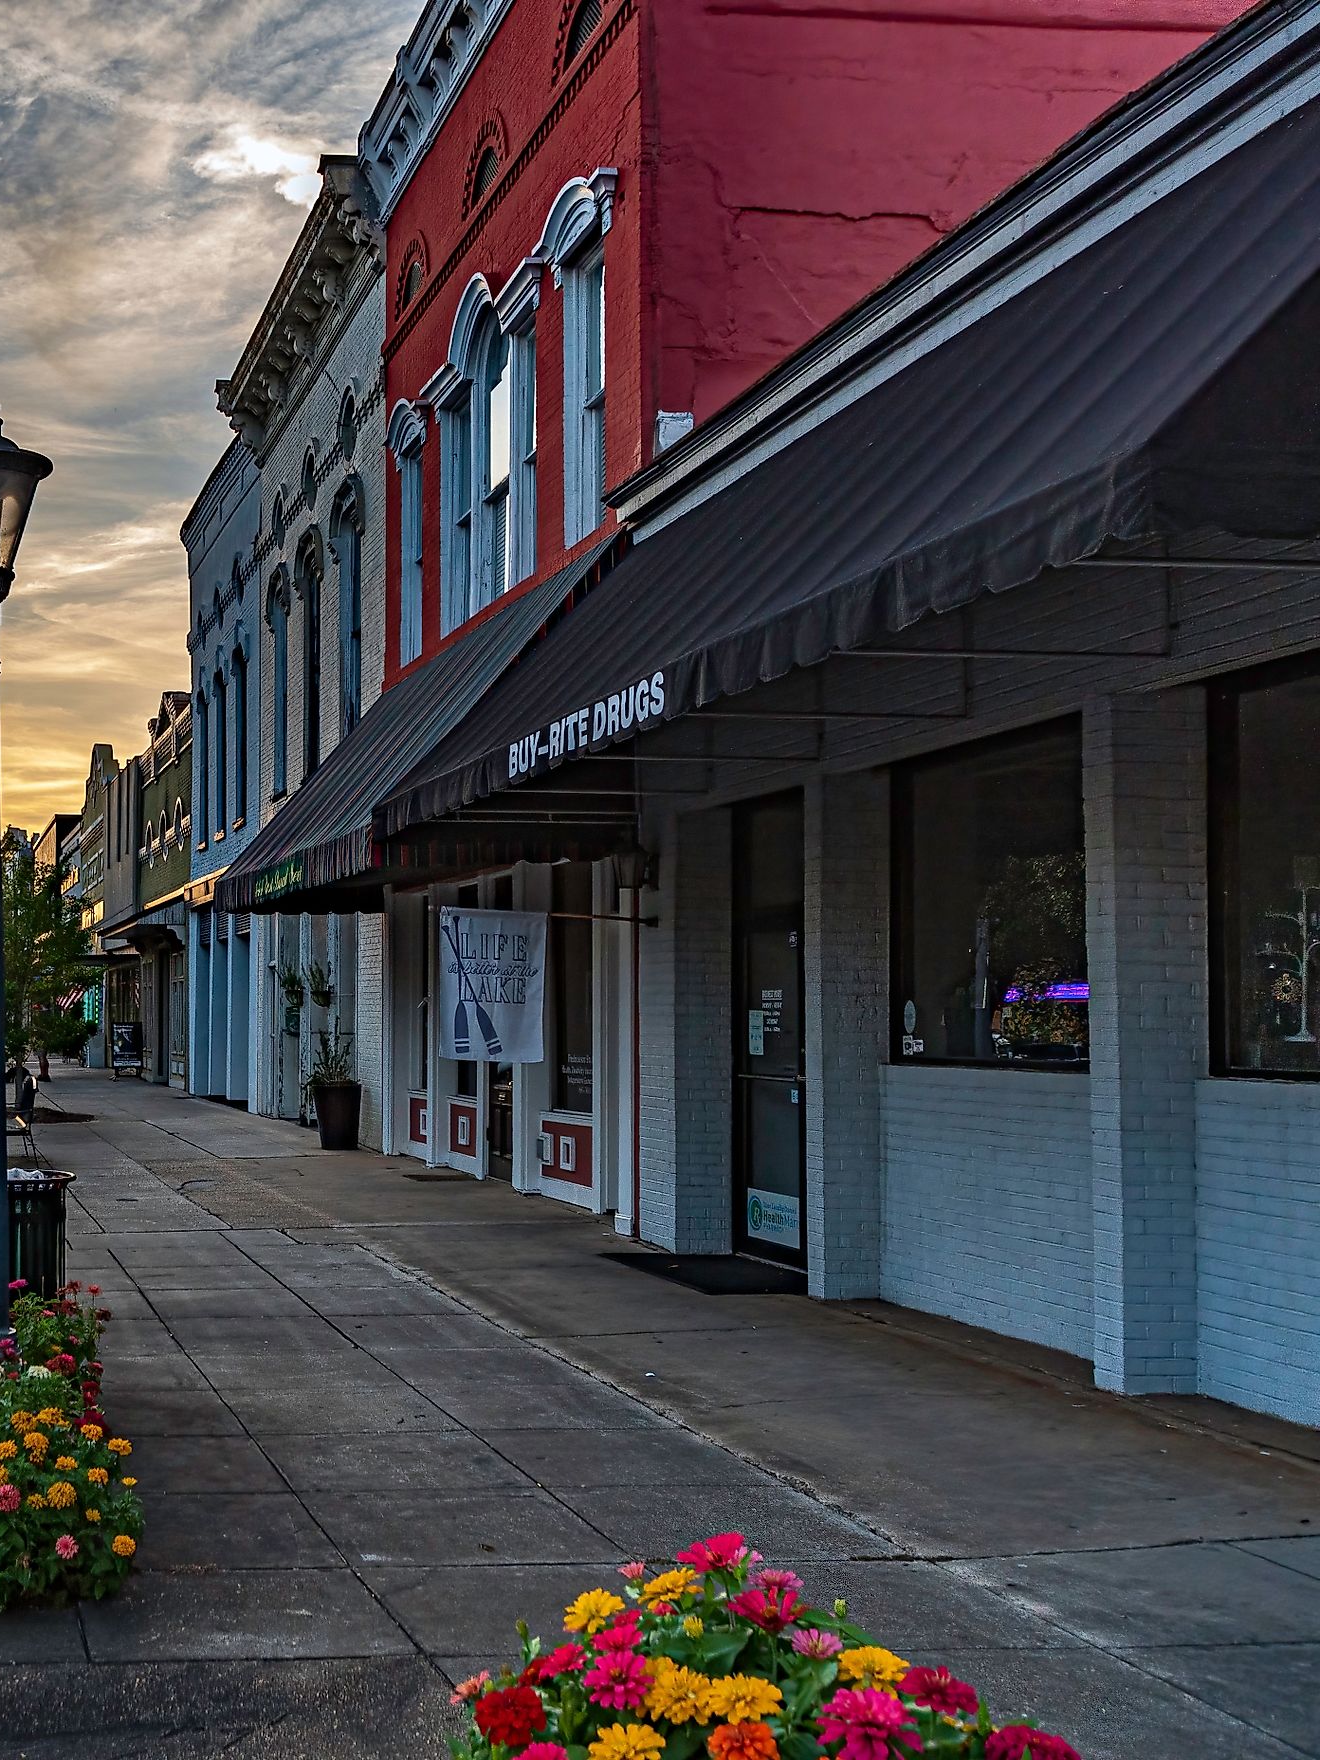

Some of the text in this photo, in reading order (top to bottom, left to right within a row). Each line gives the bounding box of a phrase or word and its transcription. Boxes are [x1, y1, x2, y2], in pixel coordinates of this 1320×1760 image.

[508, 671, 665, 779] BUY-RITE DRUGS
[460, 932, 528, 962] LIFE
[447, 960, 539, 978] is better at the
[459, 976, 527, 1004] LAKE
